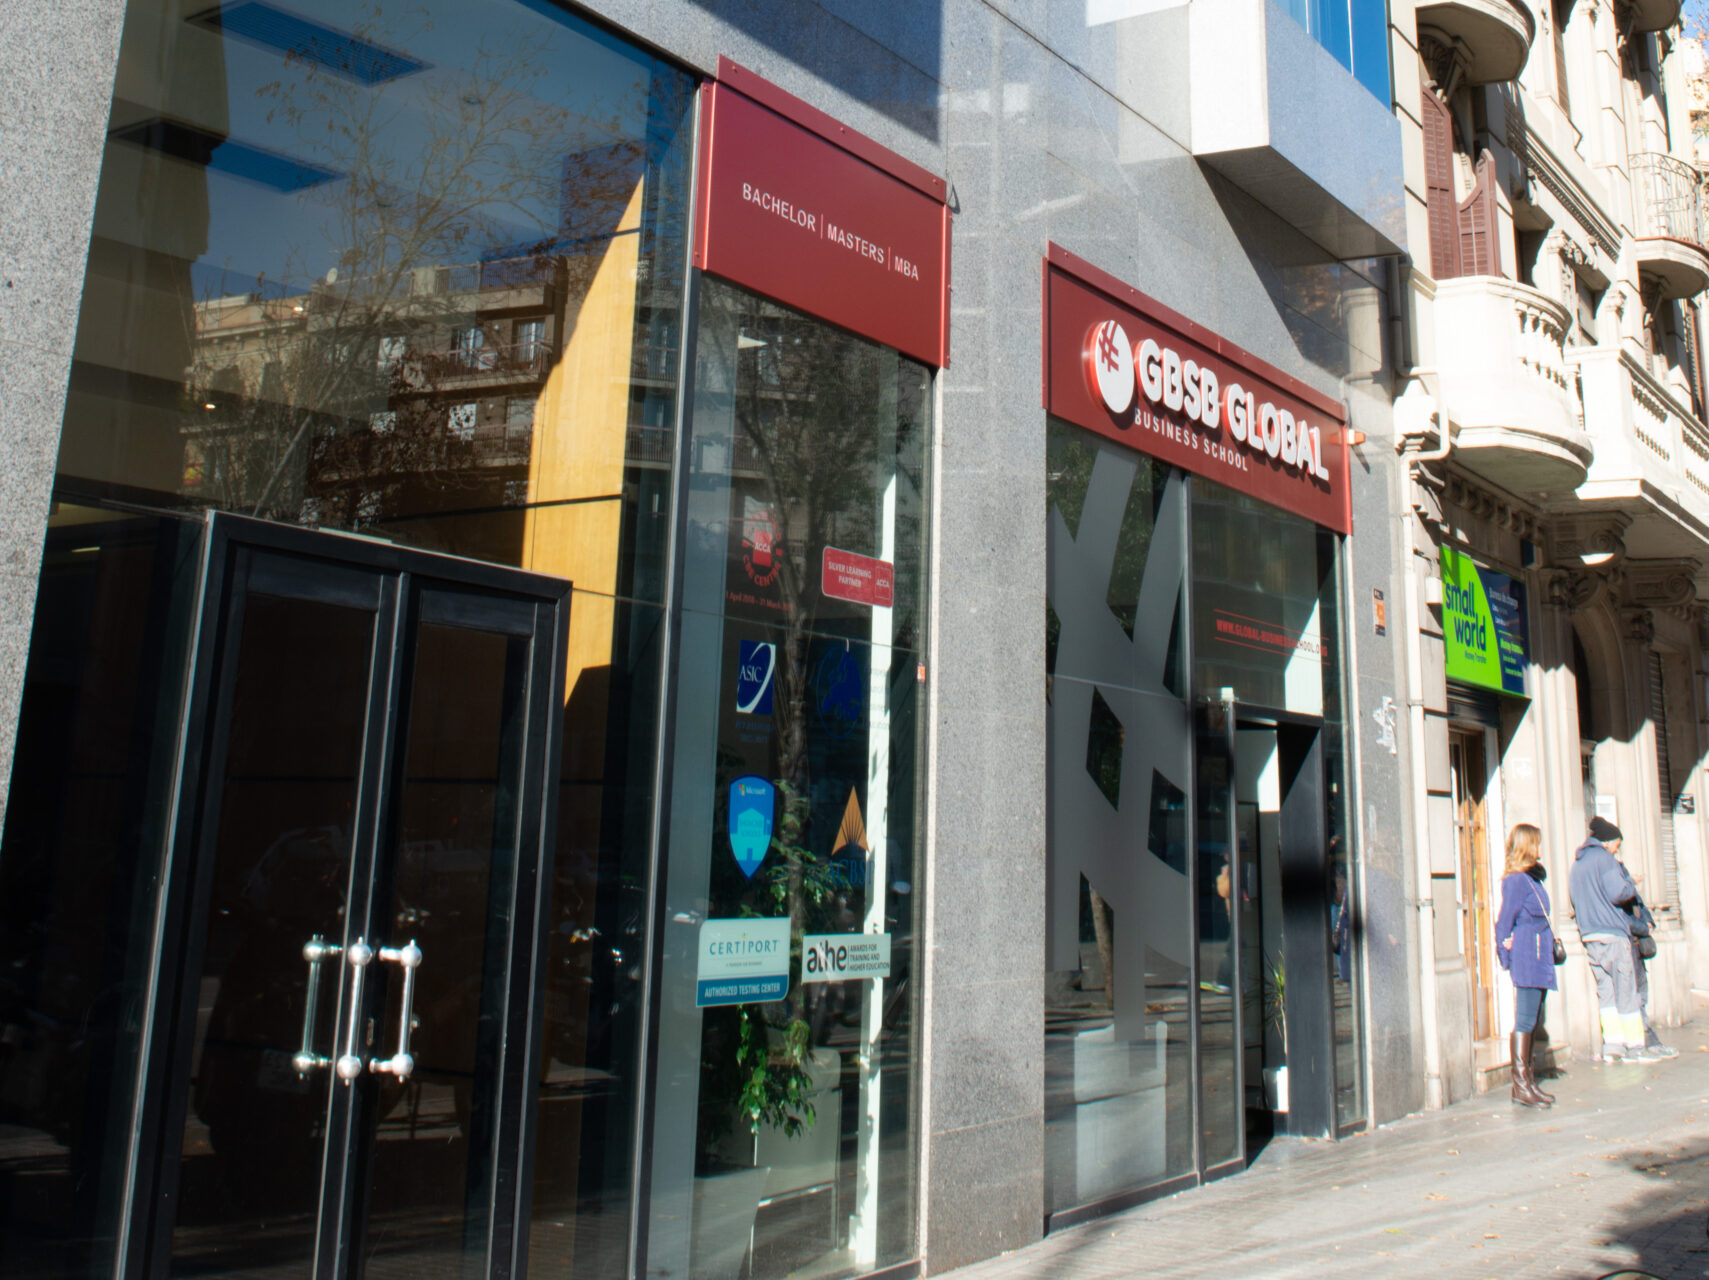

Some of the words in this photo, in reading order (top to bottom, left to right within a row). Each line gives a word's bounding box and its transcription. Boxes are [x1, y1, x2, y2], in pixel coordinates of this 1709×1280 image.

[742, 182, 816, 232] BACHELOR
[827, 223, 884, 264] MASTERS
[894, 255, 919, 281] MBA
[1136, 338, 1220, 429] GBSB
[1224, 383, 1329, 481] GLOBAL
[1134, 408, 1198, 450] BUSINESS
[1203, 438, 1248, 472] SCHOOL
[754, 541, 771, 553] ACCA
[828, 561, 846, 572] SILVER
[846, 565, 872, 579] LEARNING
[838, 574, 862, 588] PARTNER
[876, 578, 890, 587] ACCA
[1445, 580, 1475, 618] small
[1454, 612, 1486, 652] world
[740, 665, 762, 683] ASIC
[709, 939, 778, 956] CERTIPORT
[807, 939, 847, 973] athe
[850, 944, 868, 952] AWARDS
[868, 943, 877, 951] FOR
[850, 953, 869, 961] TRAINING
[870, 952, 880, 961] AND
[850, 963, 866, 971] HIGHER
[866, 962, 890, 971] EDUCATION
[704, 985, 738, 998] AUTHORIZED
[739, 983, 760, 996] TESTING
[761, 982, 780, 994] CENTER
